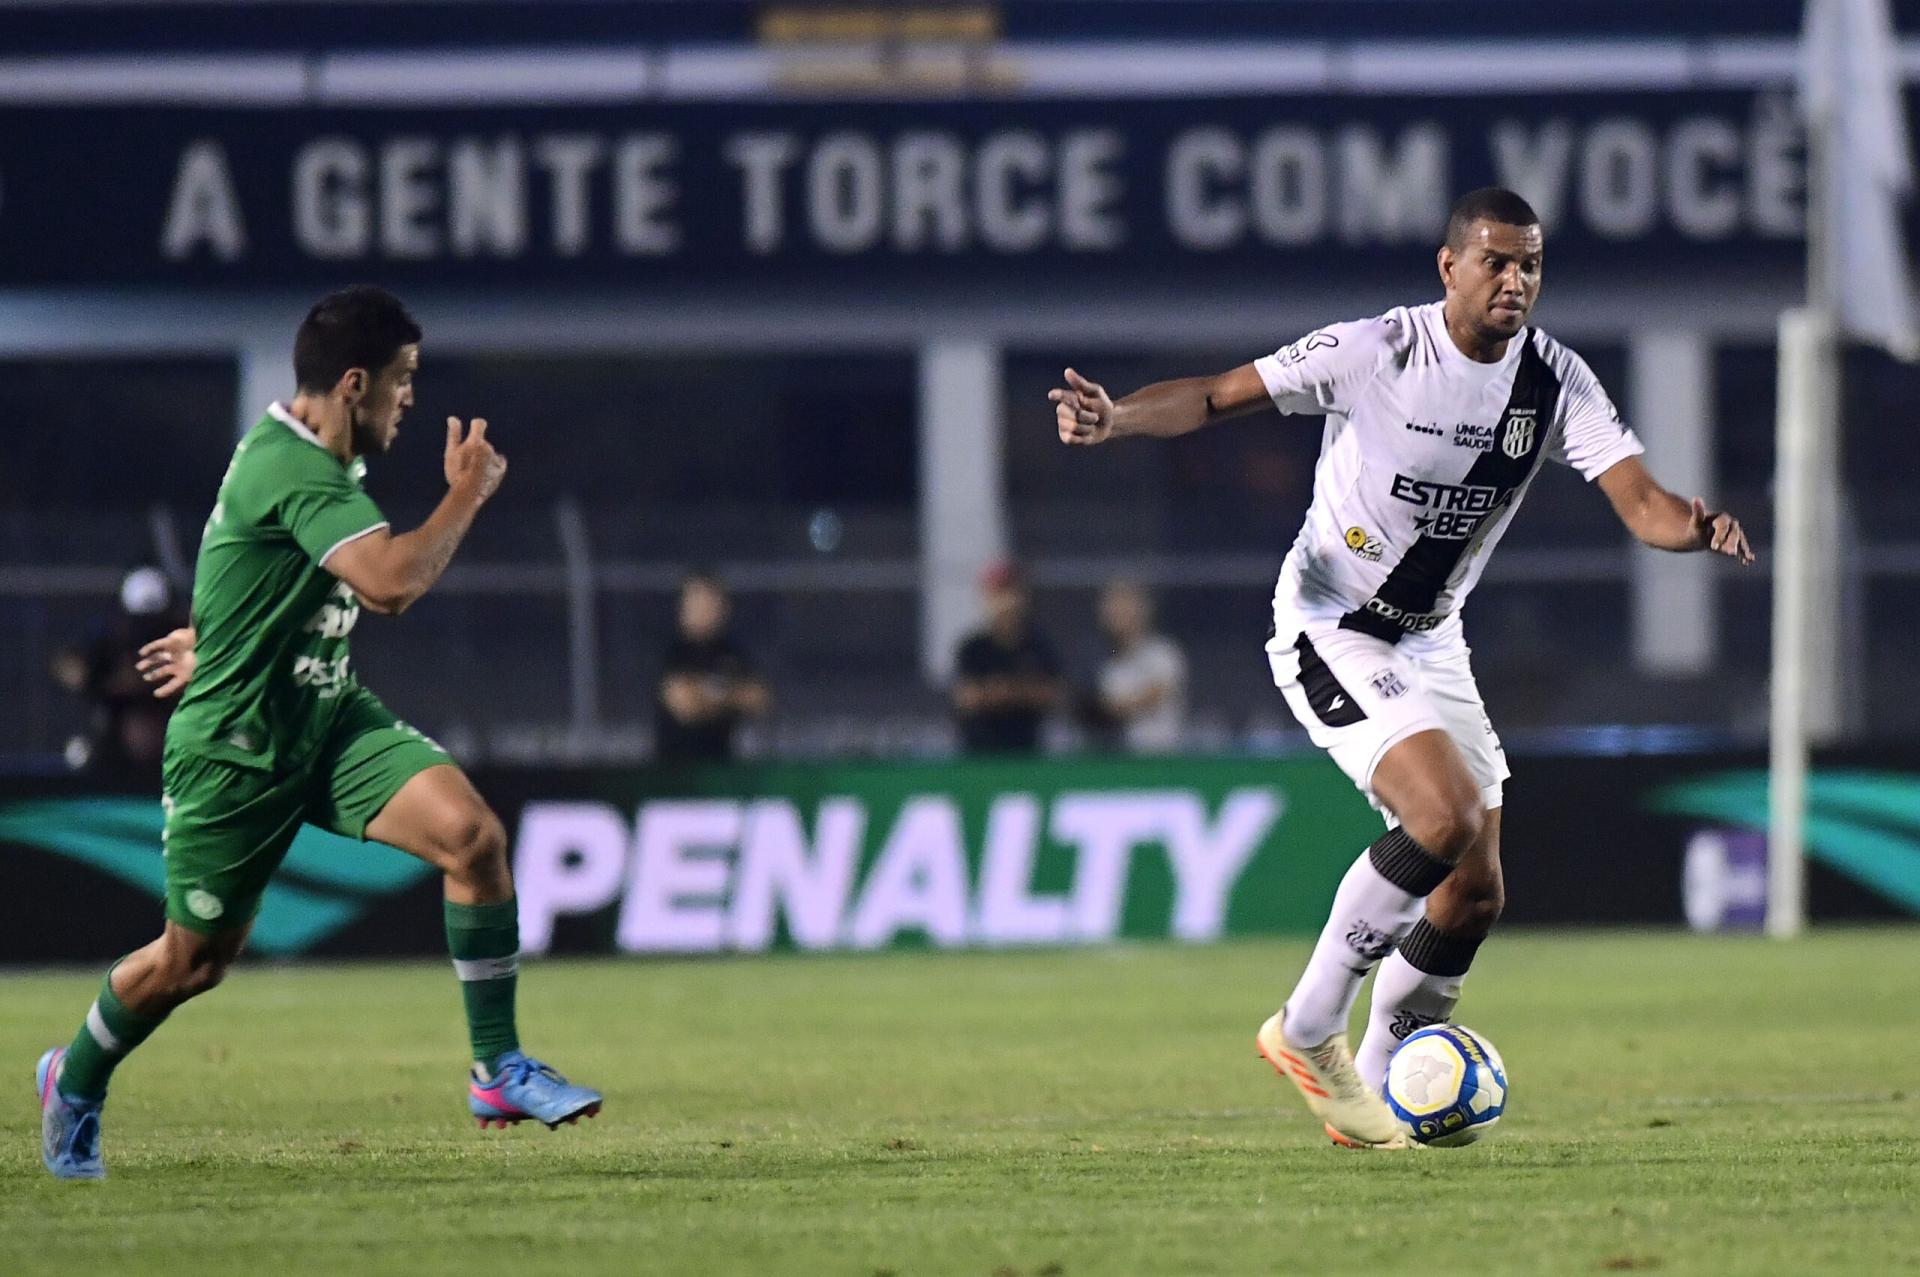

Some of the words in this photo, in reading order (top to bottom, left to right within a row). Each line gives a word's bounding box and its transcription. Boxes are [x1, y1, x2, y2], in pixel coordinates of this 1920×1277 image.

[163, 142, 247, 261] A
[293, 132, 680, 260] GENTE
[727, 128, 1126, 255] TORCE
[1167, 122, 1450, 248] COM
[1488, 92, 1806, 242] VOCÊ
[1390, 473, 1514, 512] ESTRELA
[516, 789, 1281, 954] PENALTY
